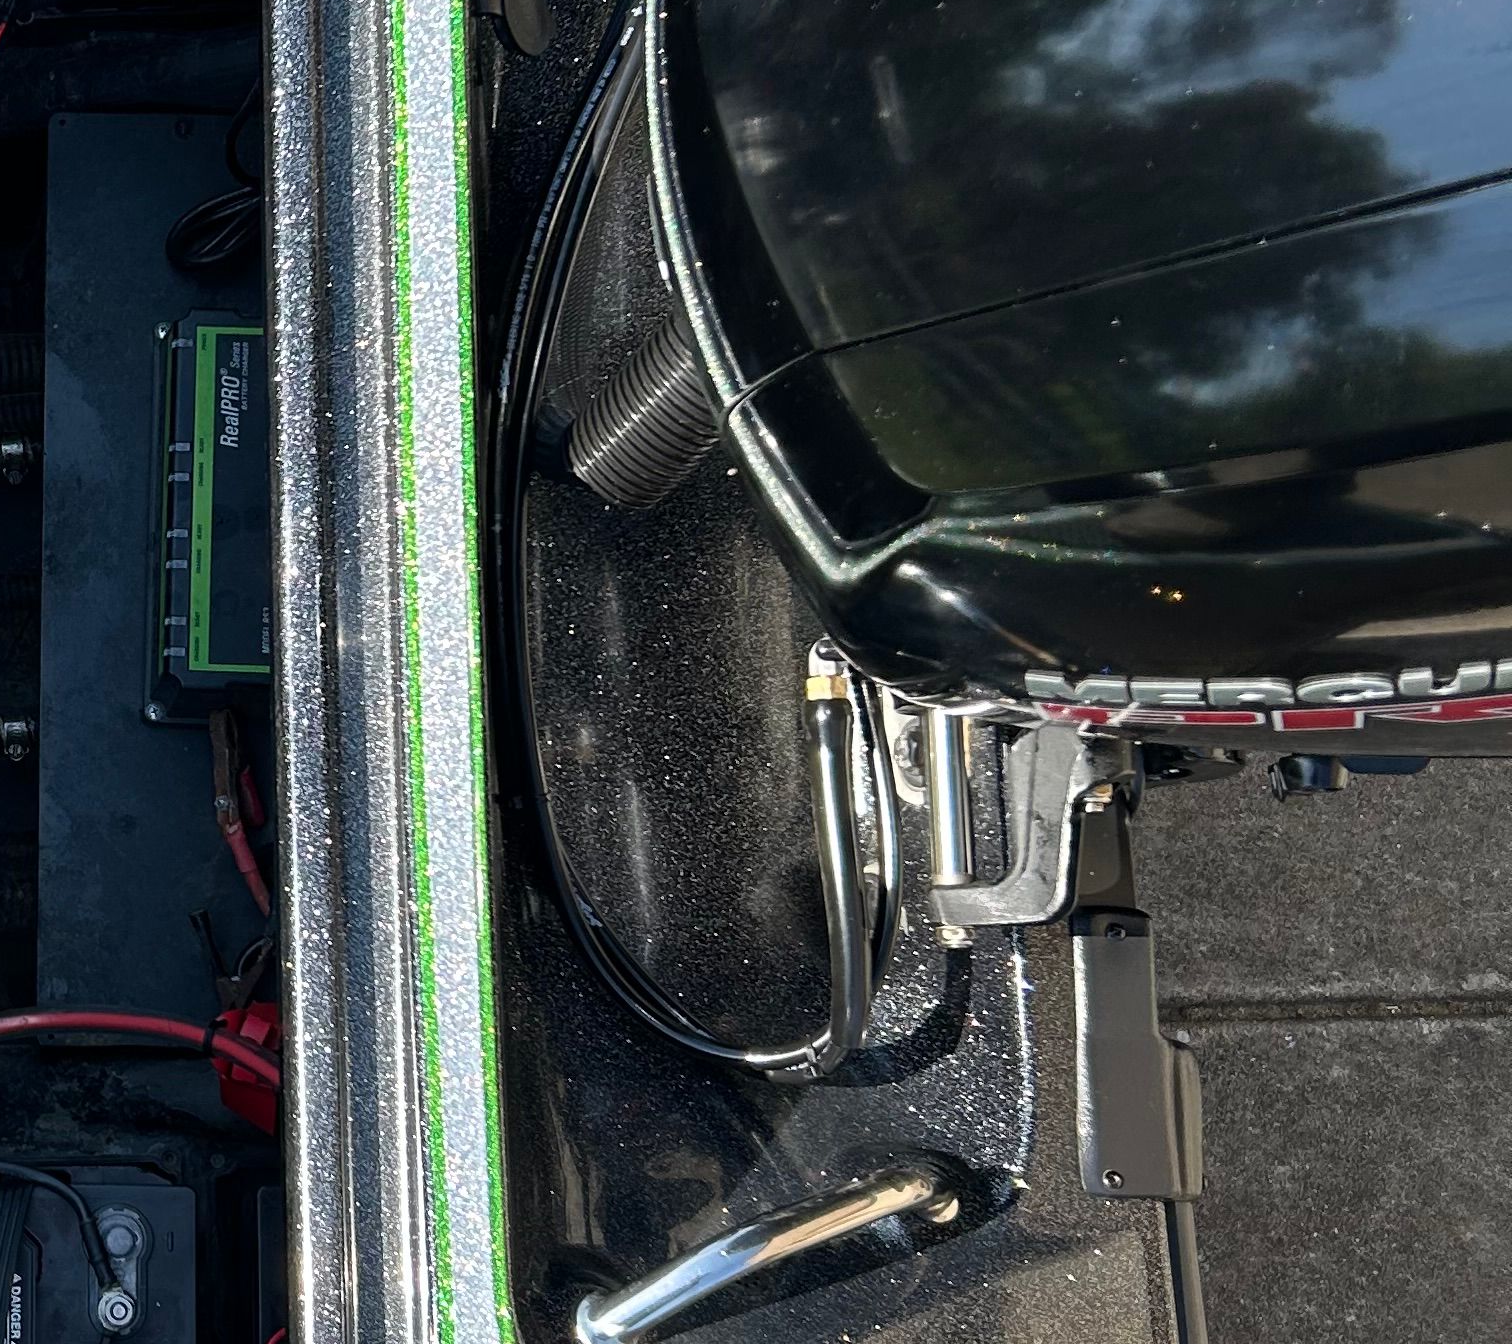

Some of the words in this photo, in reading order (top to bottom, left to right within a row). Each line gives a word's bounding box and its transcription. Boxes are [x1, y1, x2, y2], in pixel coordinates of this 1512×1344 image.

[230, 341, 241, 369] Series
[241, 341, 249, 377] CHARGER
[240, 378, 248, 411] BATTERY
[11, 1285, 22, 1339] DANGER
